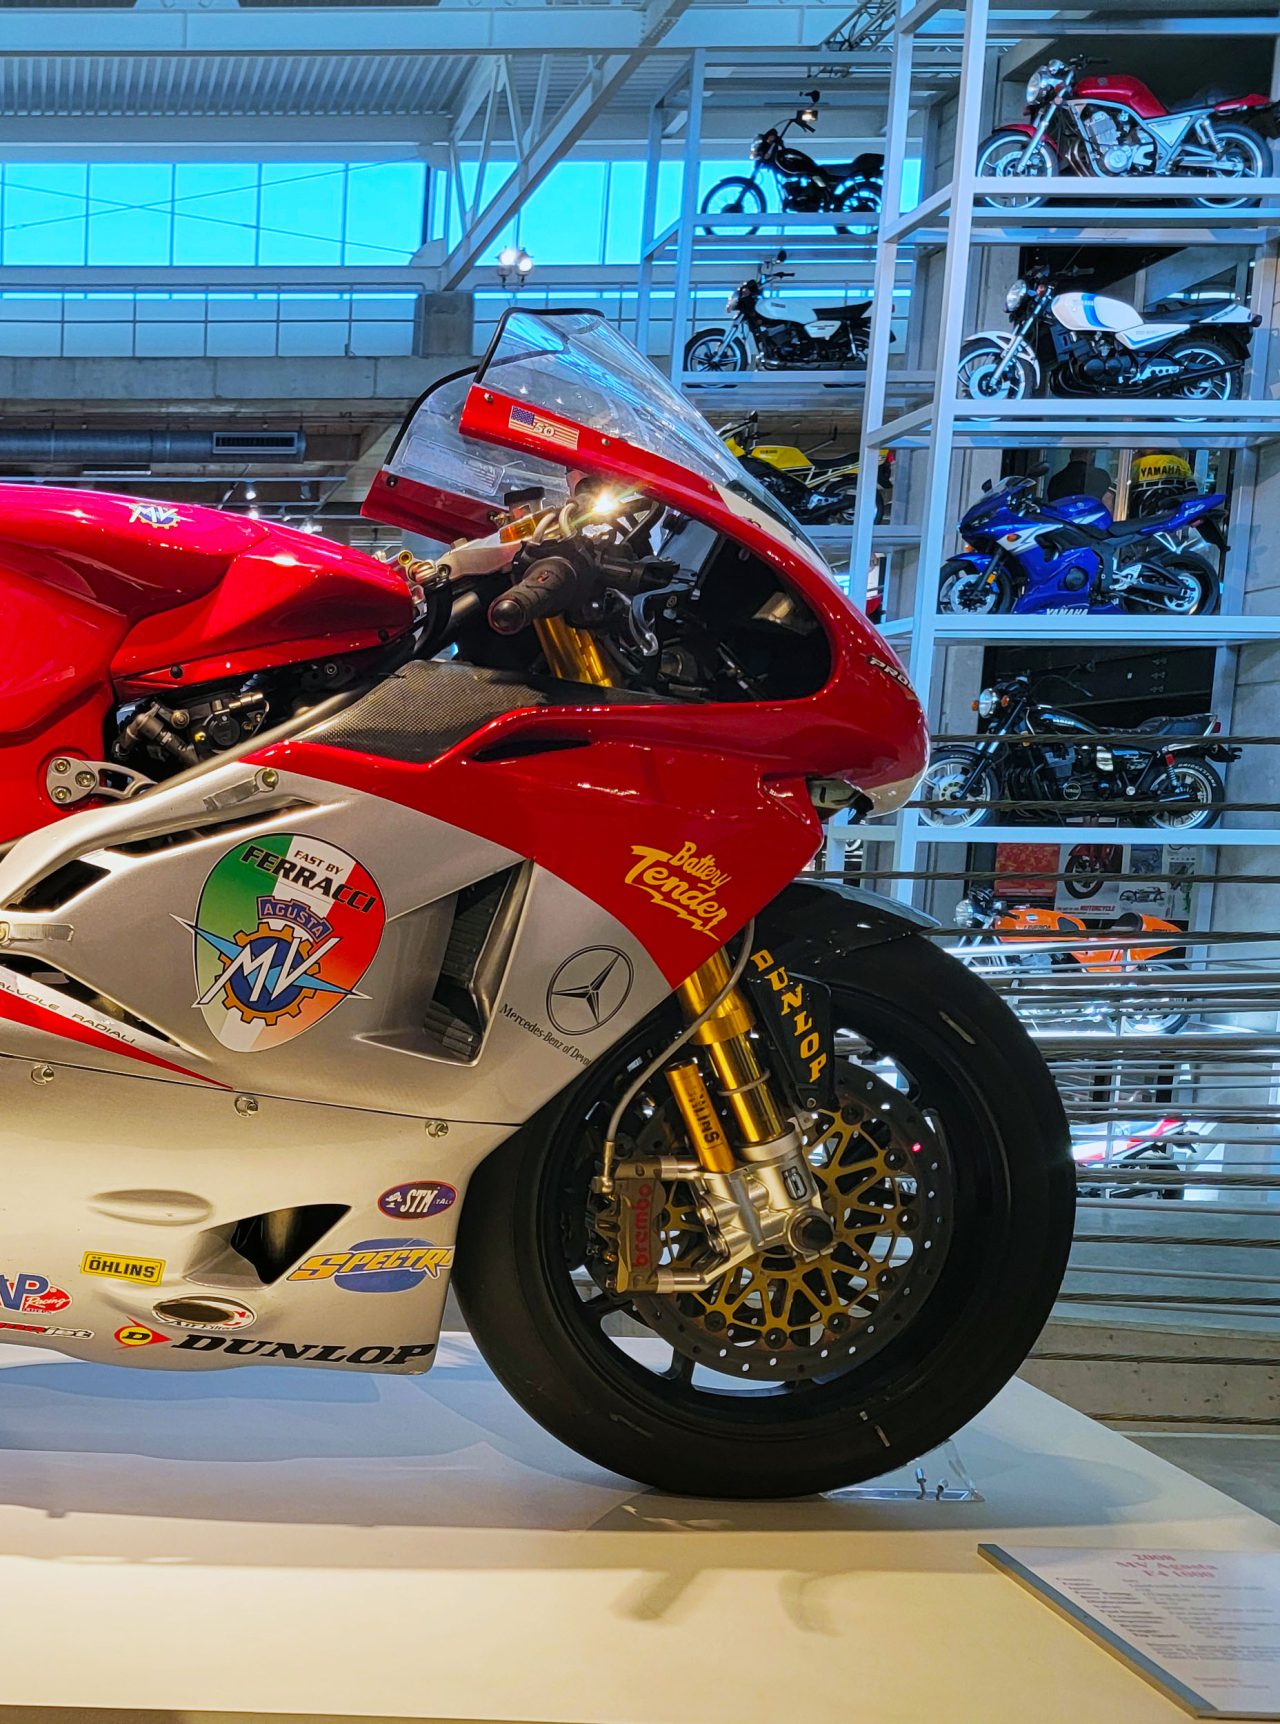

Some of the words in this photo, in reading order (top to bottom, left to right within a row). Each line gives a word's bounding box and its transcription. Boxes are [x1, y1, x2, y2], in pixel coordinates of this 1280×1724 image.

[1140, 465, 1182, 477] YAMAHA
[240, 845, 376, 914] FERRACCI
[293, 849, 326, 869] FAST
[325, 859, 344, 877] BY
[671, 841, 732, 892] Battery
[625, 845, 728, 938] Tender
[263, 902, 324, 938] AGUSTA
[196, 937, 343, 1005] MV
[71, 1012, 137, 1045] RADIALI
[498, 1003, 564, 1050] Mercedes-Benz
[562, 1045, 575, 1055] of
[750, 949, 827, 1083] DUNLOP
[633, 1183, 653, 1268] brembo
[25, 1294, 70, 1308] Racing
[171, 1333, 437, 1366] DUNLOP
